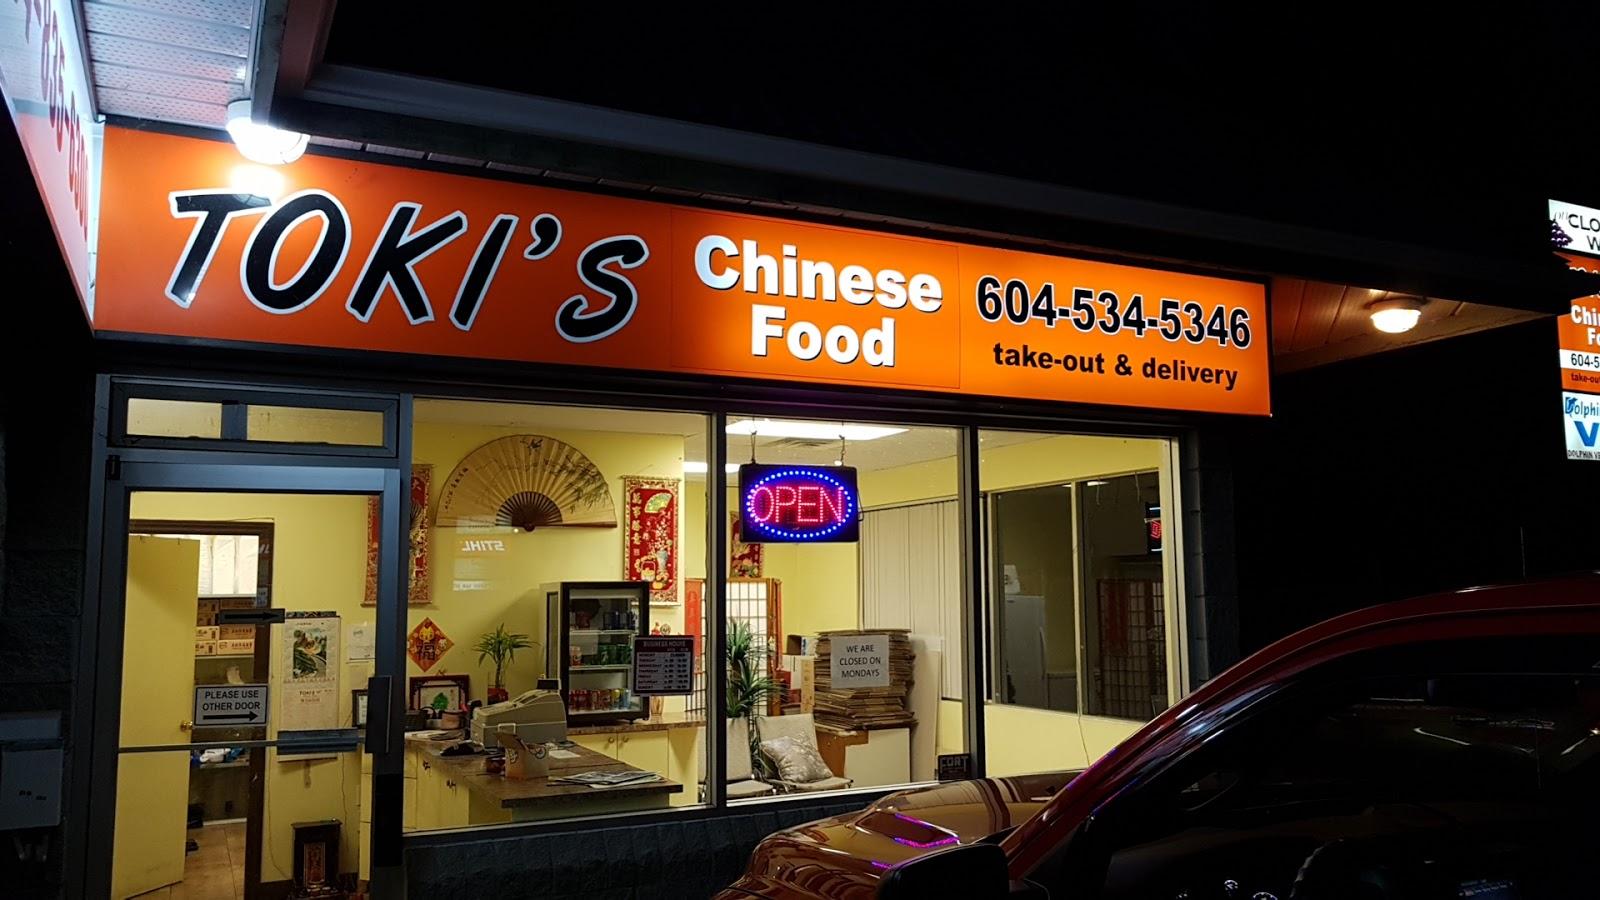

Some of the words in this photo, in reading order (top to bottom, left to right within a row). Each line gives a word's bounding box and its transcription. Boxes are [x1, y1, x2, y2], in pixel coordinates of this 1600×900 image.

[166, 188, 650, 343] TOKI'S
[694, 234, 943, 313] Chinese
[975, 274, 1252, 349] 604-534-5346
[750, 303, 896, 368] Food
[993, 342, 1105, 376] take-out
[1114, 353, 1134, 377] &
[1141, 357, 1239, 391] delivery
[750, 486, 842, 522] OPEN
[839, 657, 868, 666] CLOSED
[869, 656, 881, 665] ON
[846, 645, 859, 653] WE
[860, 644, 874, 653] ARE
[841, 669, 880, 678] MONDAYS
[202, 701, 234, 711] OTHER
[234, 701, 260, 710] DOOR
[204, 690, 240, 699] PLEASE
[241, 690, 259, 699] USE
